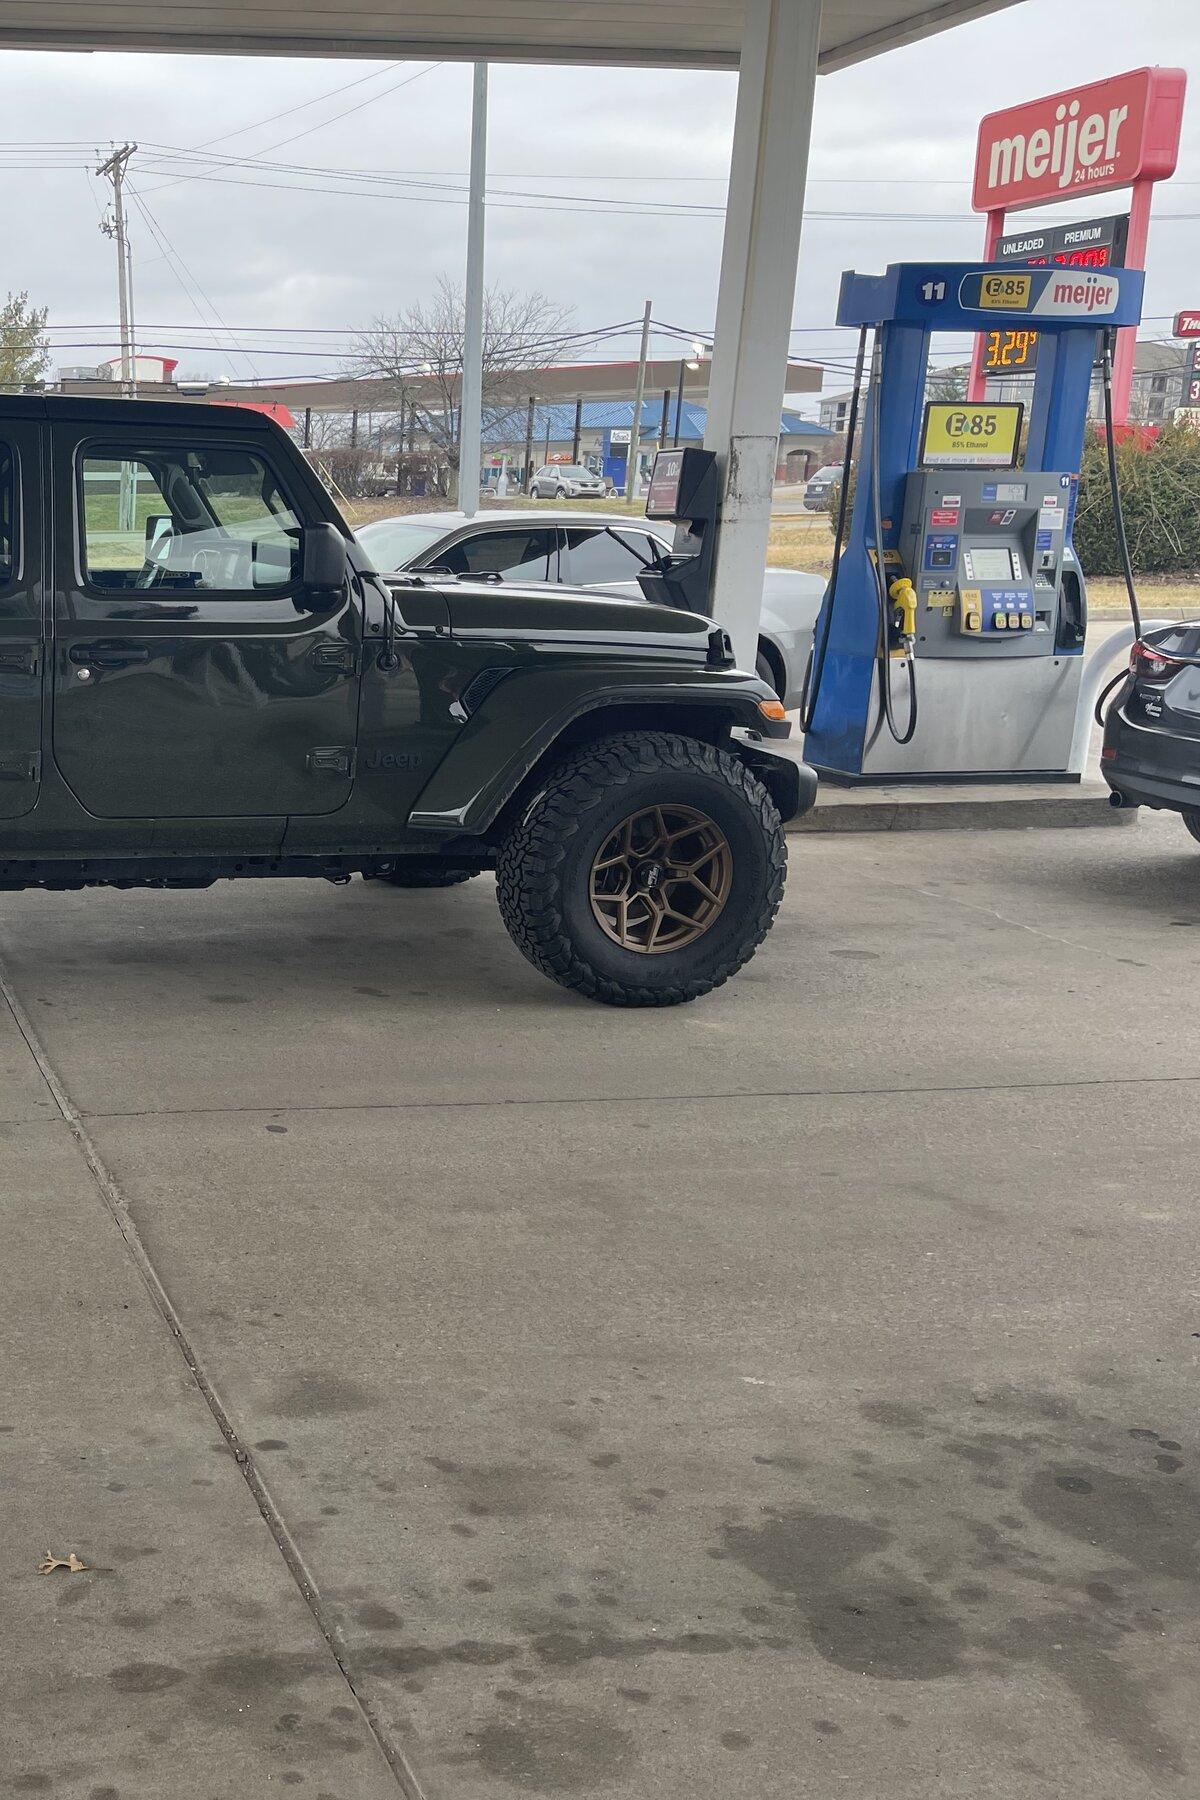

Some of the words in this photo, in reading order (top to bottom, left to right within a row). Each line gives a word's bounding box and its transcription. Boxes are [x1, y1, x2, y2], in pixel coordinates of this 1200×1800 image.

[988, 99, 1128, 189] meijer
[1075, 169, 1086, 183] 24
[1087, 163, 1115, 180] hours
[1064, 226, 1102, 244] PREMIUM
[1003, 237, 1044, 255] UNLEADED
[921, 281, 946, 301] 11
[1053, 276, 1113, 311] meijer
[966, 441, 989, 449] Ethanol
[1061, 476, 1070, 486] 11
[366, 750, 422, 769] Jeep
